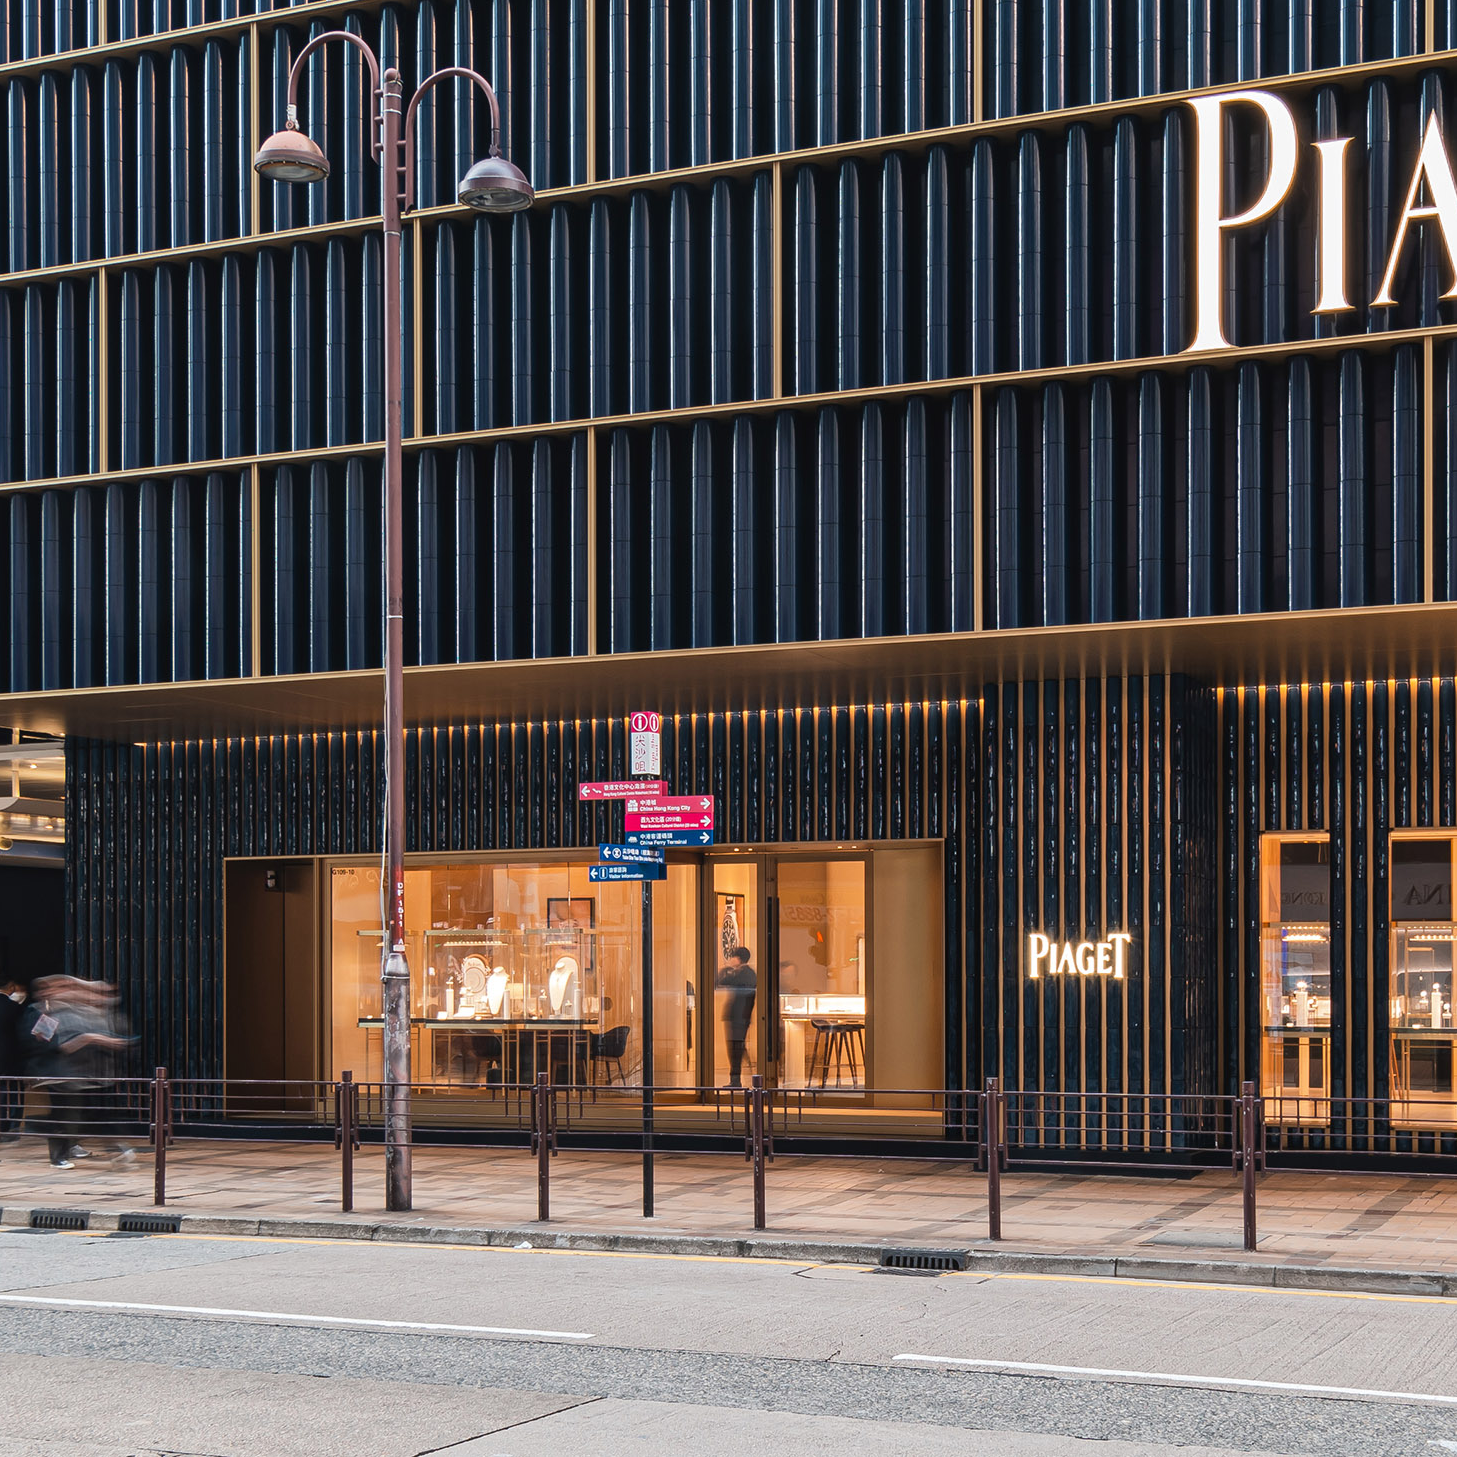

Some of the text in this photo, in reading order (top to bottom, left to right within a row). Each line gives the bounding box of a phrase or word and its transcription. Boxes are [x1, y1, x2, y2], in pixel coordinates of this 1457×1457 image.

[635, 735, 646, 772] 尖沙咀
[1029, 933, 1131, 978] PIAGET
